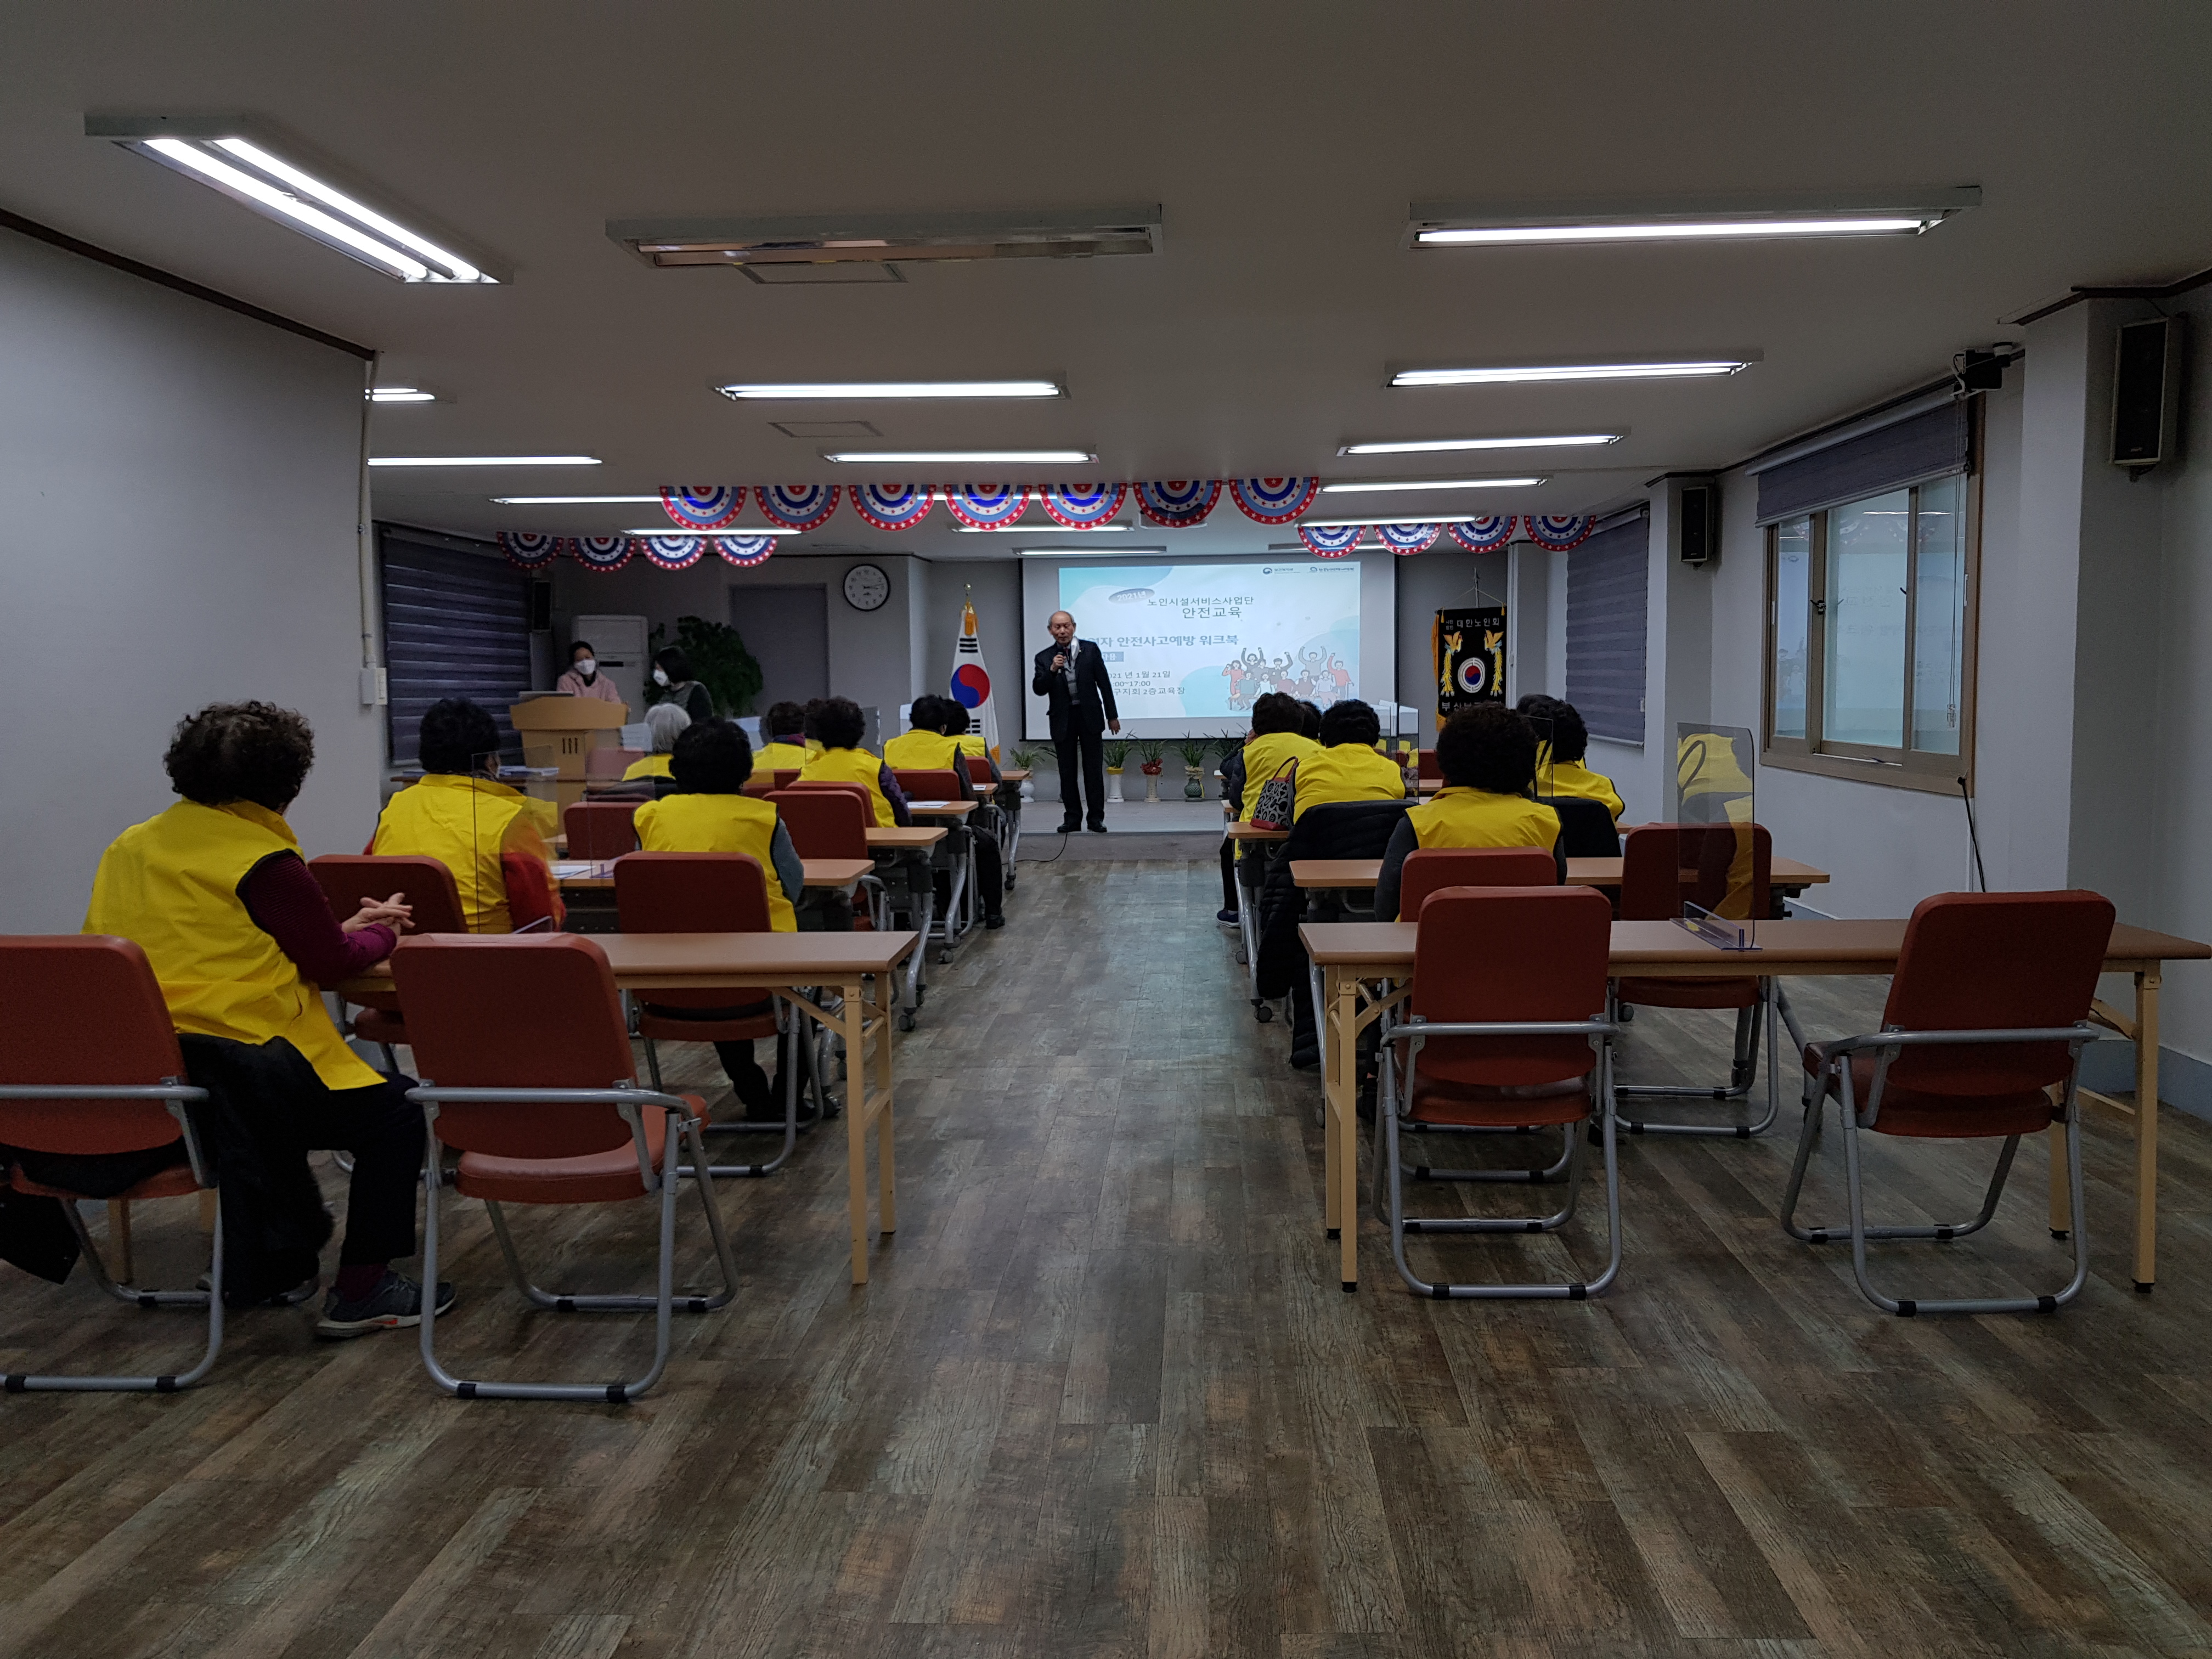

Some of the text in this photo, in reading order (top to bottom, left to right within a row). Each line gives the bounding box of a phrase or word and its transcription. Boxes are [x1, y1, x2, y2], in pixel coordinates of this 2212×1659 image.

[1117, 590, 1147, 602] 2021년
[1147, 596, 1255, 606] 노인시설서비스사업단
[1182, 606, 1243, 619] 안전교육
[1457, 617, 1499, 628] 대한노인회
[1117, 635, 1196, 647] 안전사고예방
[1199, 635, 1239, 646] 워크북
[1125, 670, 1133, 679] 년
[1136, 670, 1149, 679] 1월
[1143, 687, 1186, 696] 2층교육장
